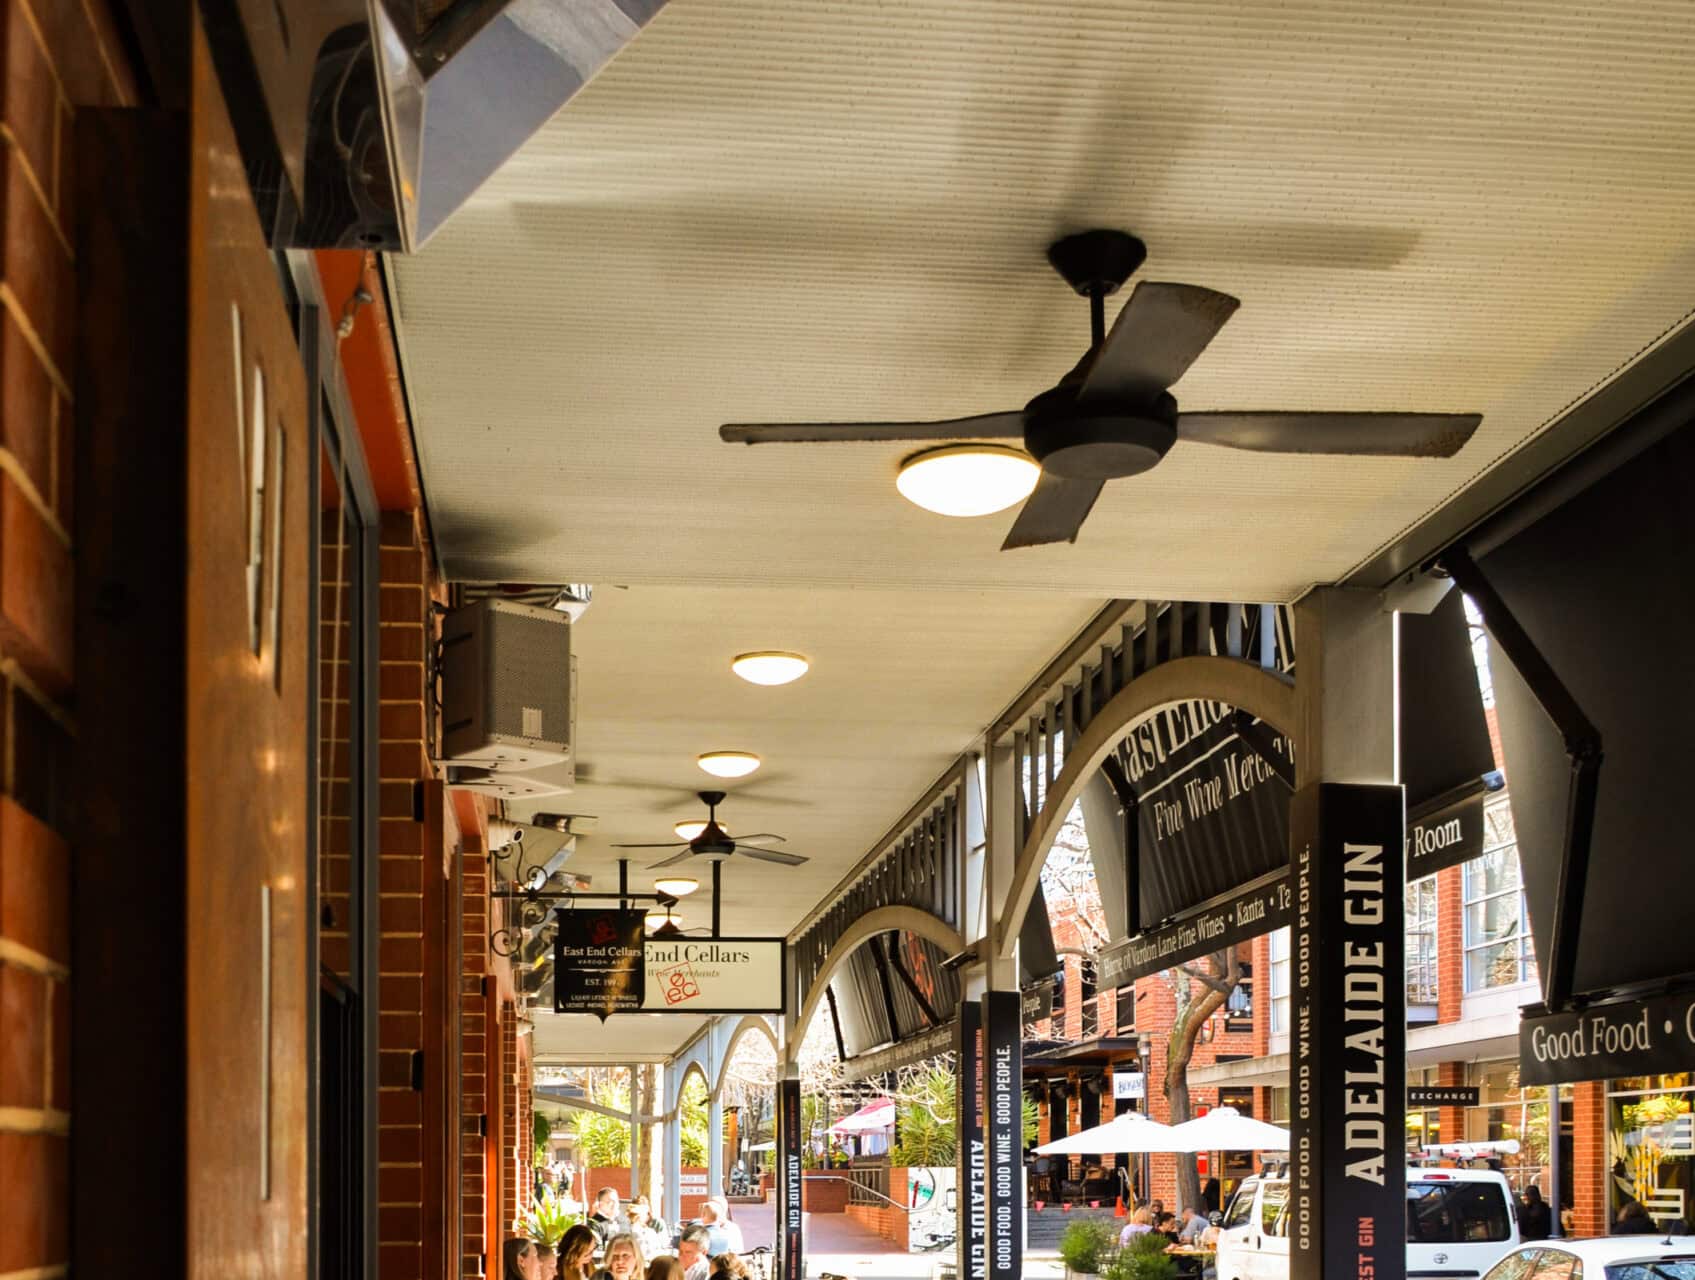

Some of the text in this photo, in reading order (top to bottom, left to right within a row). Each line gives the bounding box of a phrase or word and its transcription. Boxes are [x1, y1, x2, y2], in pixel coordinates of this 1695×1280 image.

[1153, 800, 1184, 841] Fine
[1184, 775, 1223, 821] Wine
[1413, 818, 1463, 858] Room
[1158, 934, 1177, 955] Lane
[1177, 923, 1197, 950] Fine
[1196, 910, 1225, 942] Wines
[1236, 898, 1265, 926] Kanta
[563, 946, 642, 958] East End Cellars
[645, 945, 750, 964] End Cellars
[1344, 842, 1386, 1186] ADELAIDE GIN
[1532, 1017, 1585, 1063] Good
[1591, 1006, 1651, 1056] Food
[975, 1028, 985, 1058] WINNER
[1299, 843, 1311, 1250] GOOD FOOD. GOOD WINE. GOOD PEOPLE.
[1411, 1092, 1473, 1100] EXCHANGE
[997, 1044, 1012, 1270] GOOD FOOD. GOOD WINE. GOOD PEOPLE.
[788, 1154, 800, 1207] ADELAIDE
[788, 1209, 800, 1229] GIN
[971, 1139, 985, 1279] ADELAIDE GIN
[1358, 1216, 1376, 1247] GIN
